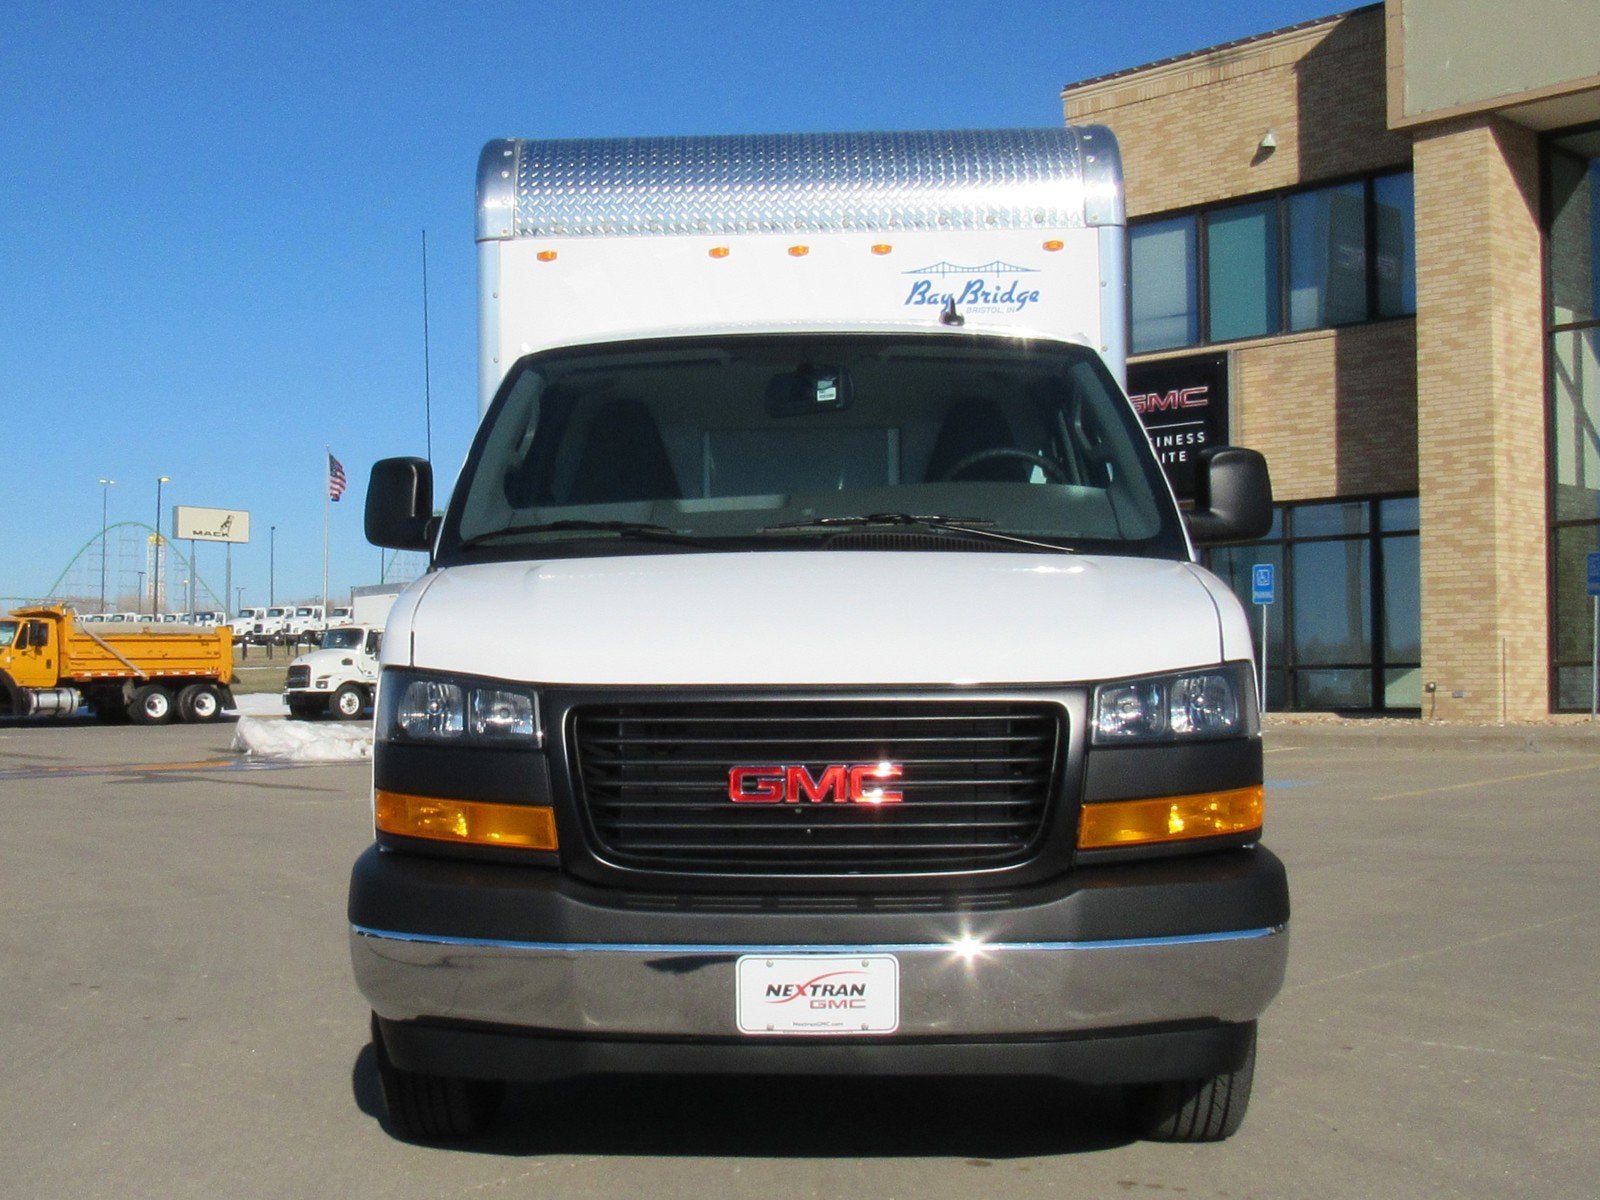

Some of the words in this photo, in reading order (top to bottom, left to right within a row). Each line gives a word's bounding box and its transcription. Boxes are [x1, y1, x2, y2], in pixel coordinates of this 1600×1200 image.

[904, 280, 954, 312] Bay
[957, 279, 1040, 311] Bridge
[1149, 432, 1205, 448] INESS
[192, 530, 230, 538] MACK
[728, 764, 904, 803] GMC
[765, 983, 867, 997] NEXTRAN
[809, 999, 867, 1009] GMC
